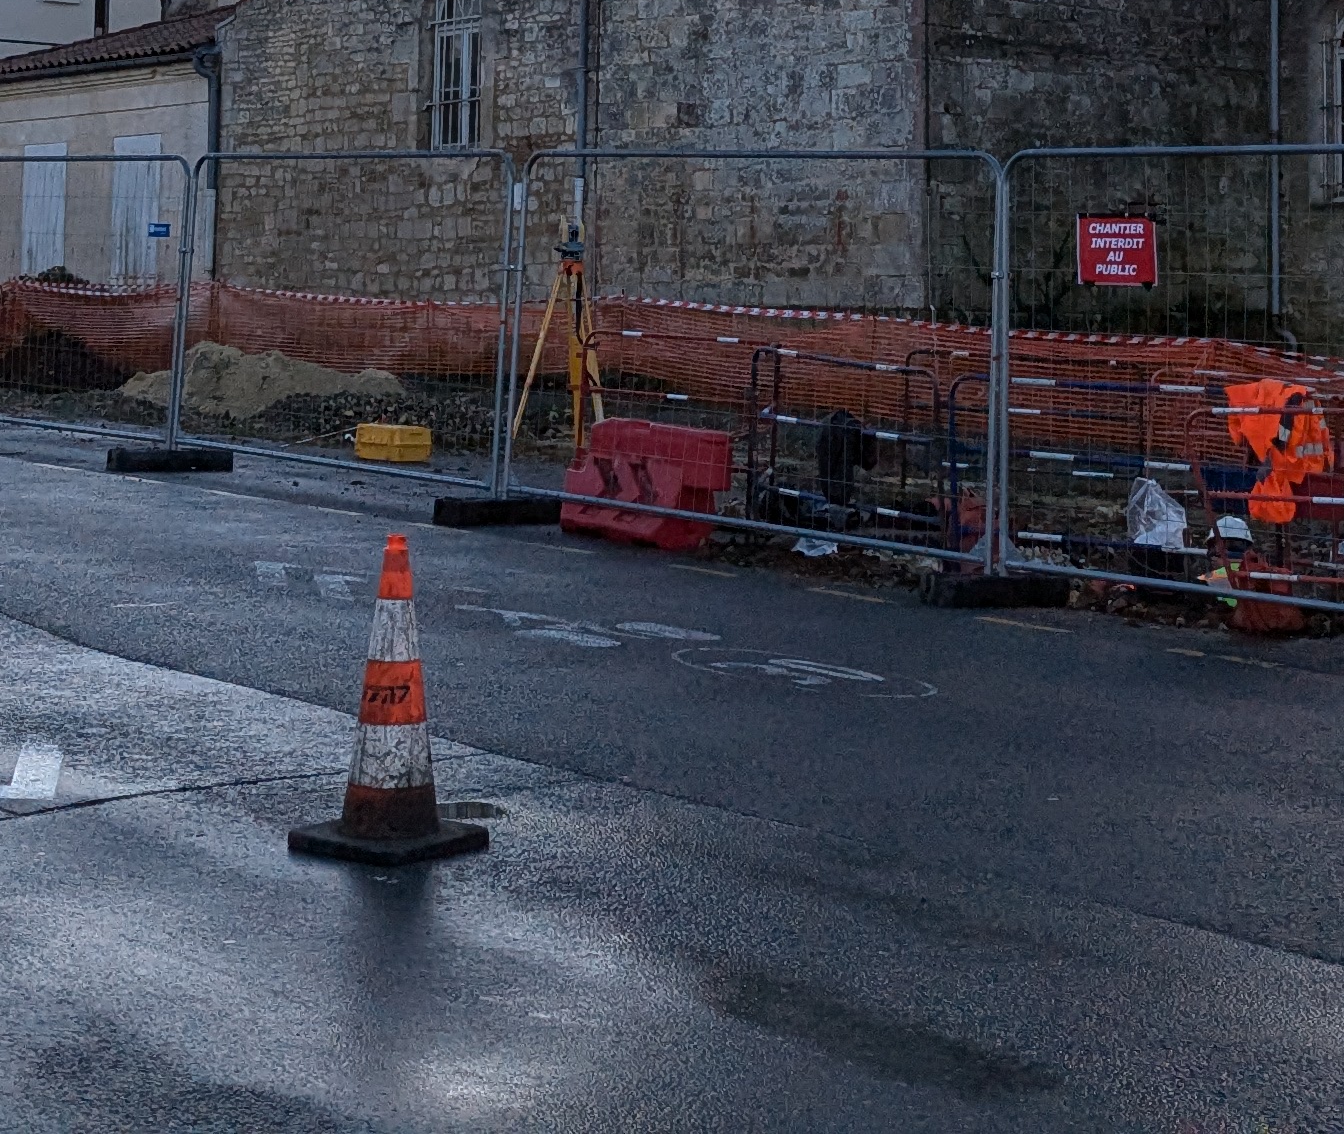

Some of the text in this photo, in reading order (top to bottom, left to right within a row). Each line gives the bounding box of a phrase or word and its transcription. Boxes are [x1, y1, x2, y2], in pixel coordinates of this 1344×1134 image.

[1089, 223, 1144, 234] CHANTIER
[1090, 238, 1145, 248] INTERDIT
[1106, 251, 1123, 261] AU
[1096, 264, 1137, 275] PUBLIC
